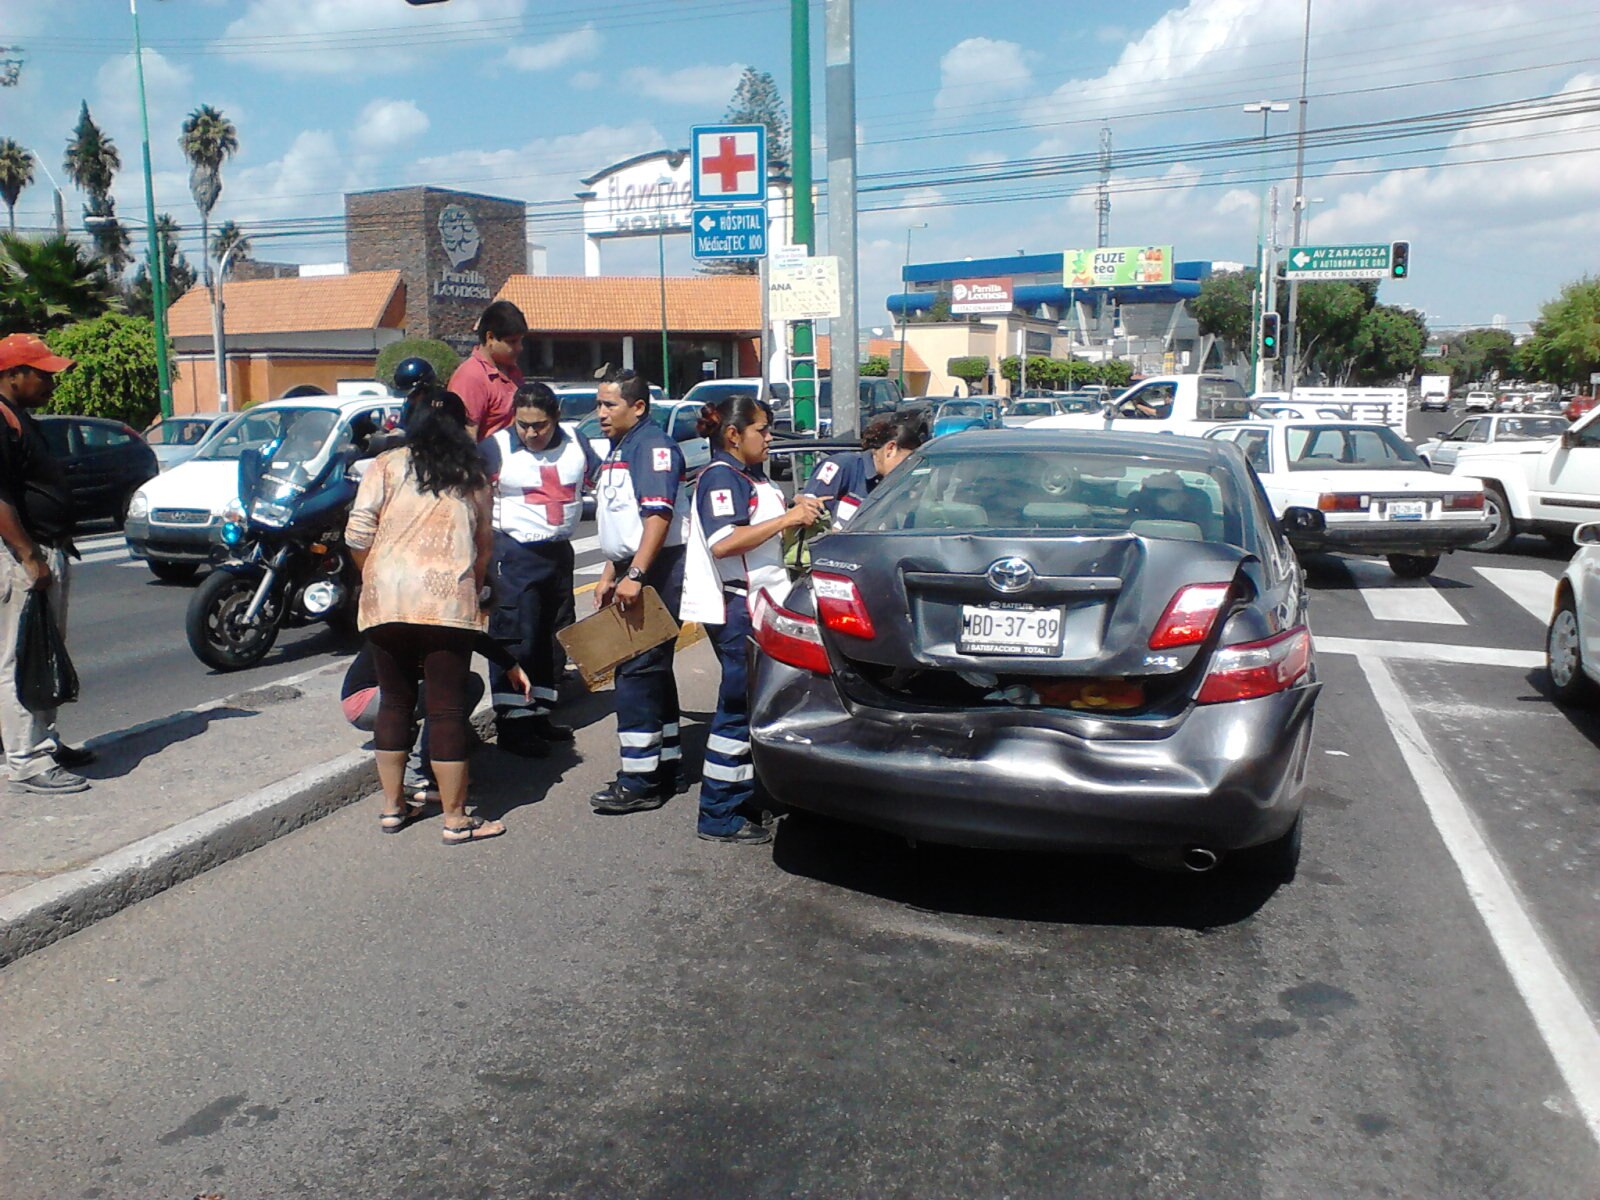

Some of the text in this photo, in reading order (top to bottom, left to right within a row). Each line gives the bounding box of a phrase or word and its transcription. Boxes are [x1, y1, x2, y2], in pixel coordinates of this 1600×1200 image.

[608, 174, 692, 223] flaming
[616, 213, 681, 231] HOTEL
[720, 214, 762, 230] HOSPITAL
[749, 234, 763, 250] 100
[1094, 252, 1126, 264] FUZE
[1313, 248, 1387, 258] AV ZARAGOZA
[1360, 258, 1369, 267] DE
[1093, 264, 1116, 274] tea
[1312, 270, 1384, 278] TECNOLOGICO
[433, 279, 491, 299] Leonesa
[972, 284, 1002, 293] Parrilla
[967, 290, 1008, 300] Leonesa
[962, 614, 1058, 639] MBD-37-89
